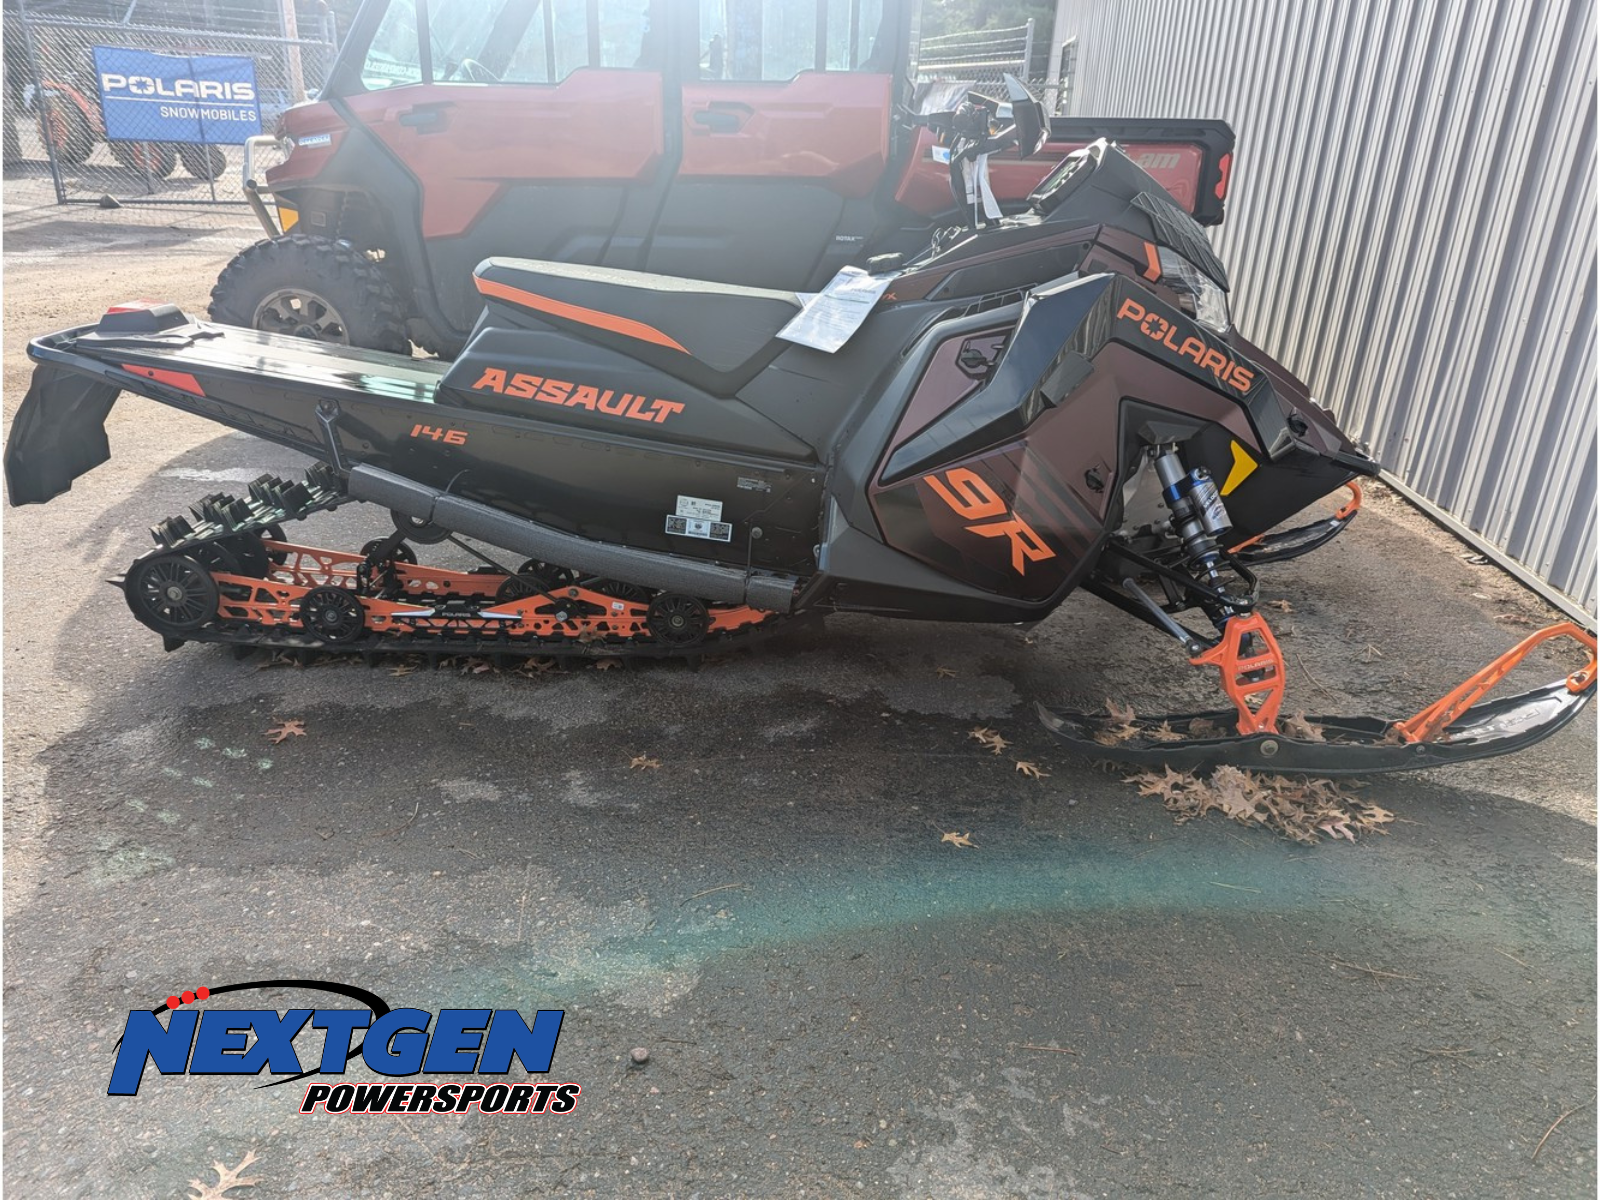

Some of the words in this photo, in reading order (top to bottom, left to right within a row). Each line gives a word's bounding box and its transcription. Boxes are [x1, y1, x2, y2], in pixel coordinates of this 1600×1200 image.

[101, 73, 255, 101] POLARIS
[160, 106, 257, 122] SNOWMOBILES
[1116, 298, 1254, 392] POLARIS
[472, 367, 686, 424] ASSAULT
[410, 424, 468, 445] 146
[923, 467, 1056, 576] 9R
